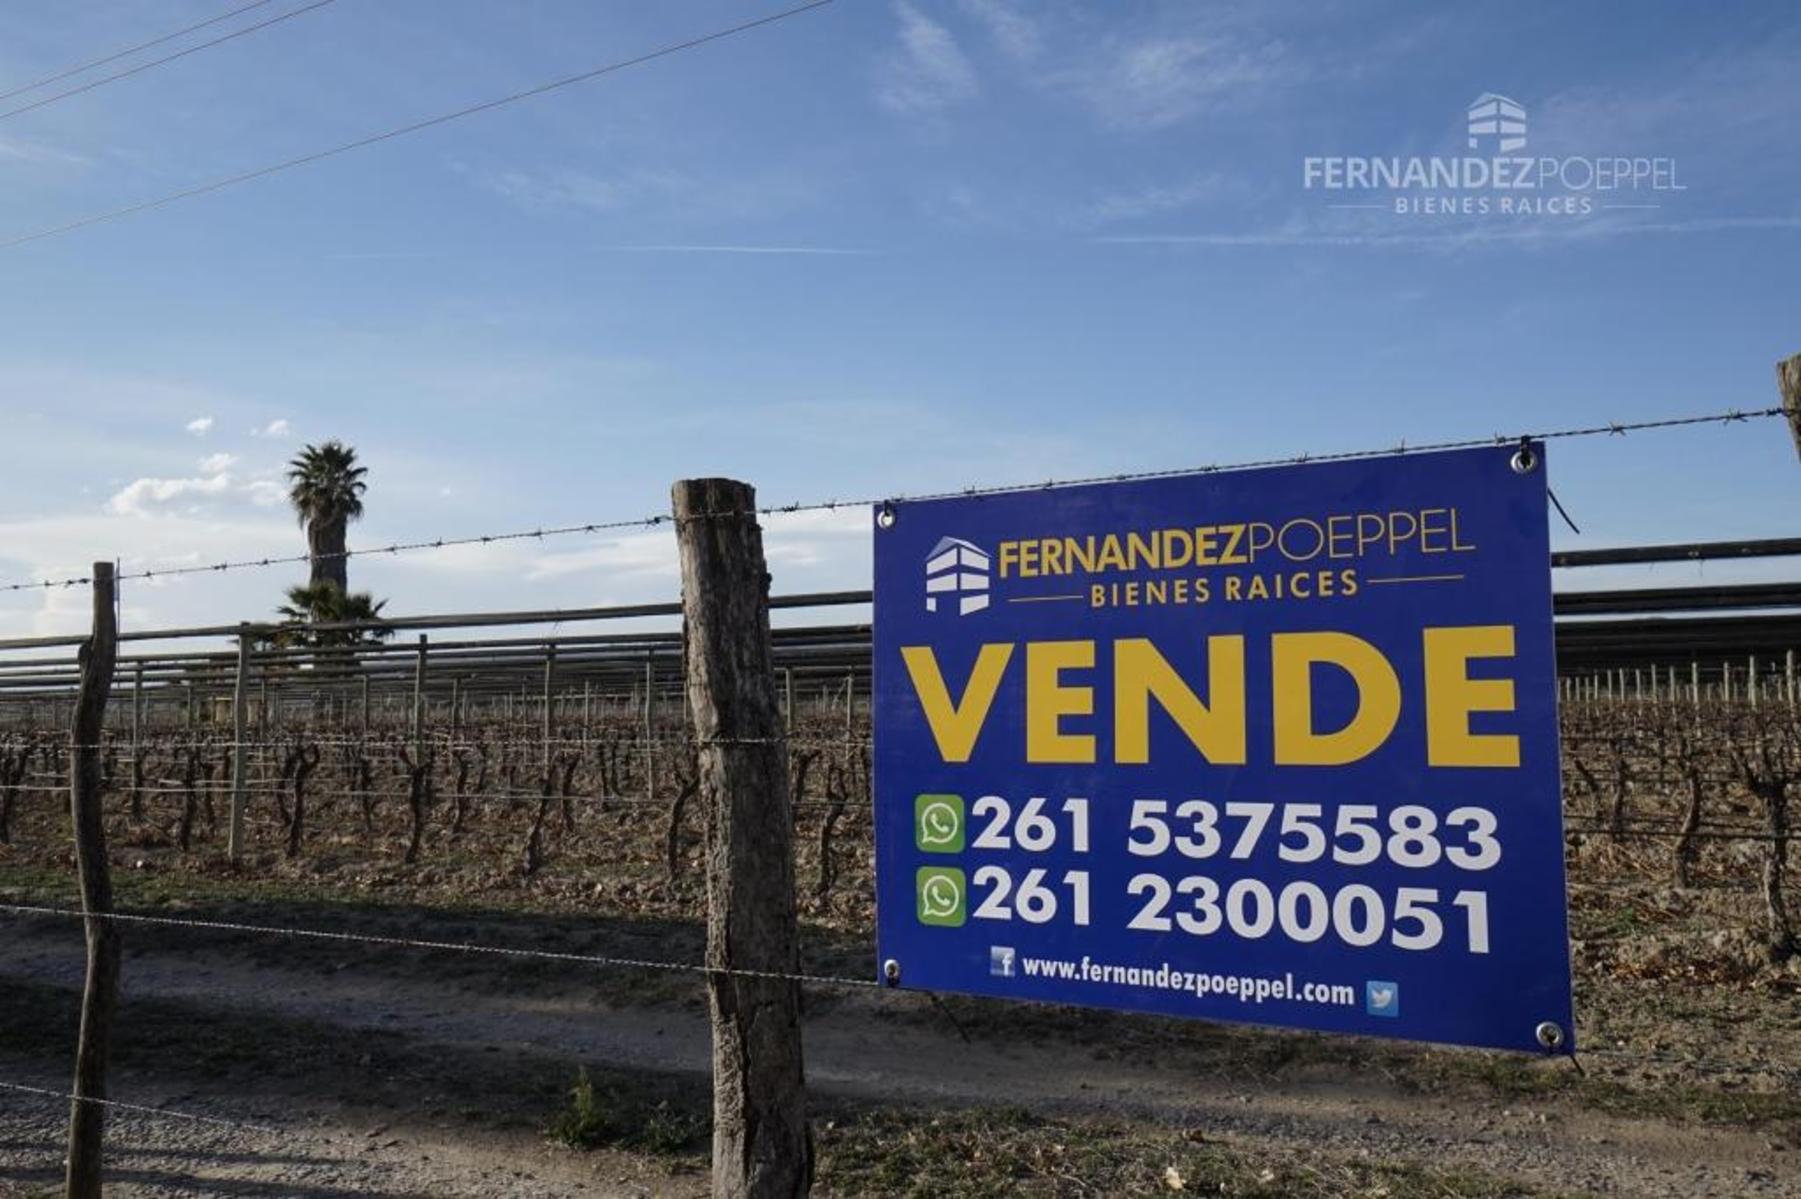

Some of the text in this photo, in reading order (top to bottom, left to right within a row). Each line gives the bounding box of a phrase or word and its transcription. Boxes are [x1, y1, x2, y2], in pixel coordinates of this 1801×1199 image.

[999, 507, 1476, 579] FERNANDEZPOEPPEL
[1091, 569, 1359, 608] BIENES RAICES
[901, 625, 1520, 768] VENDE
[971, 795, 1502, 870] 261 5375583
[972, 865, 1489, 953] 261 2300051
[1022, 954, 1355, 1006] www.fernandezpoeppel.com
